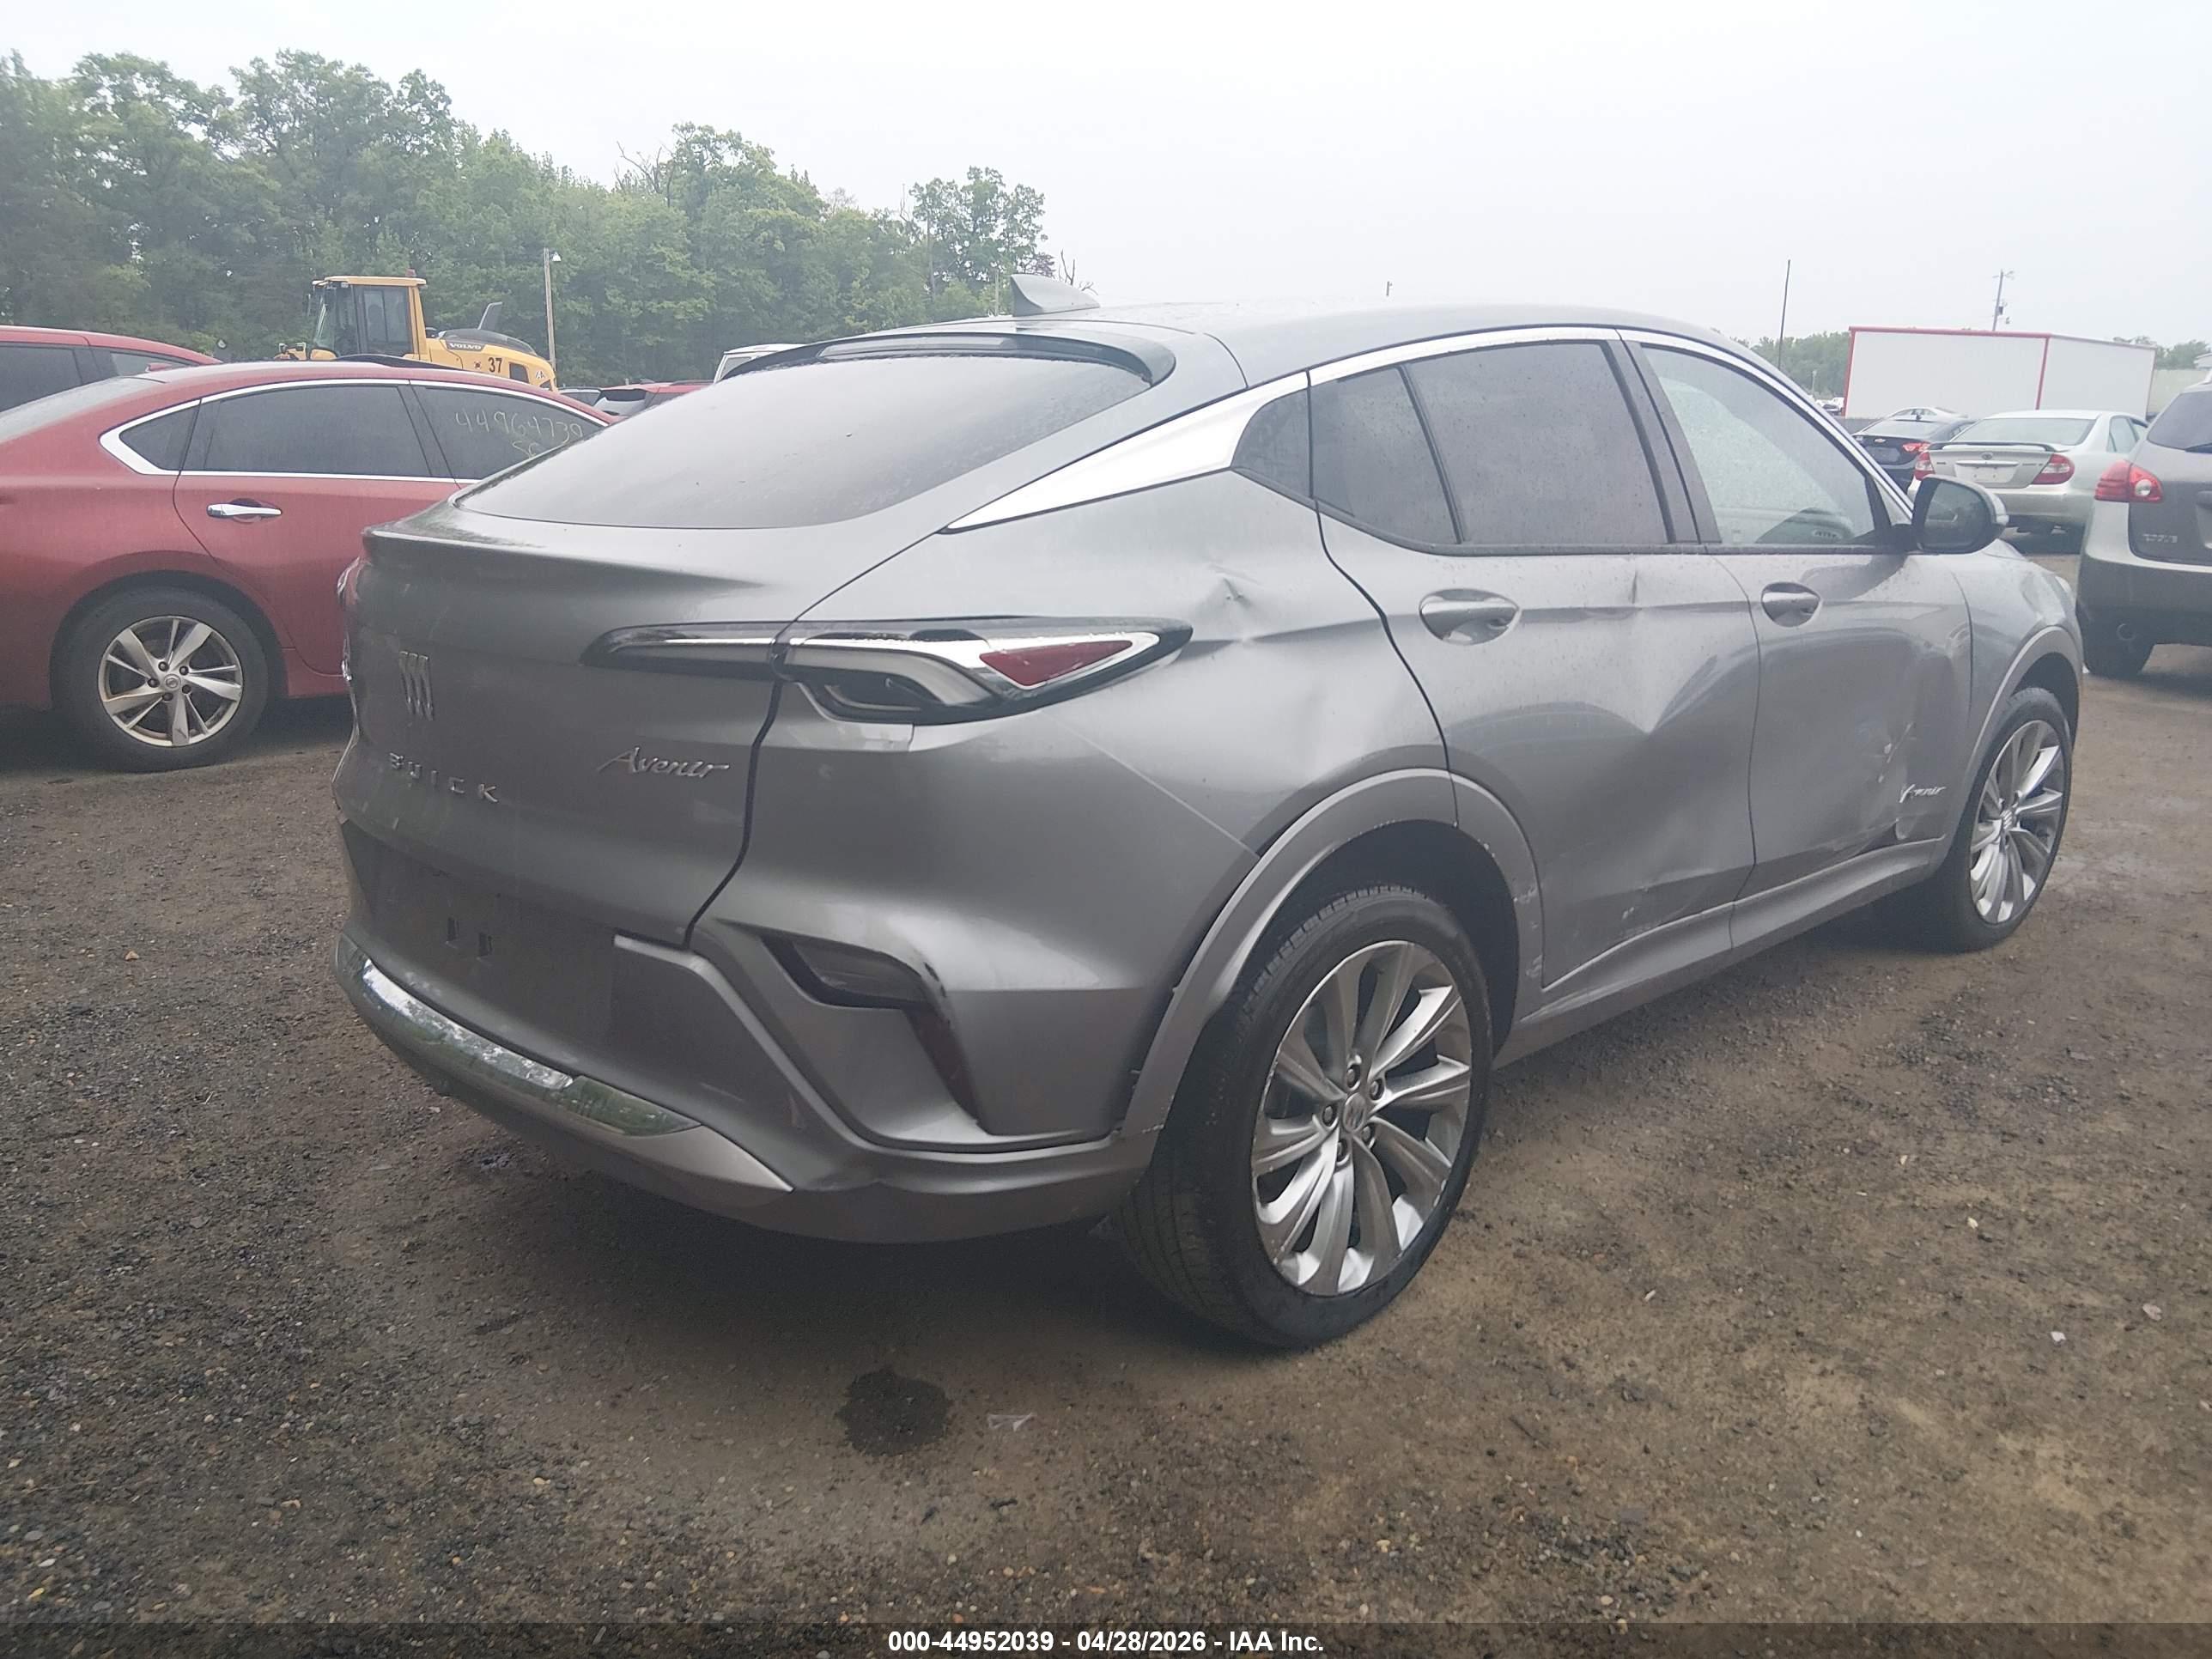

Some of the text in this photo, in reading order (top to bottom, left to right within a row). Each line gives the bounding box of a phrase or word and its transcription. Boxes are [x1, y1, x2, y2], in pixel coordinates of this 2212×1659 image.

[488, 356, 502, 373] 37
[389, 751, 499, 803] BUICK
[596, 746, 730, 778] Avenir
